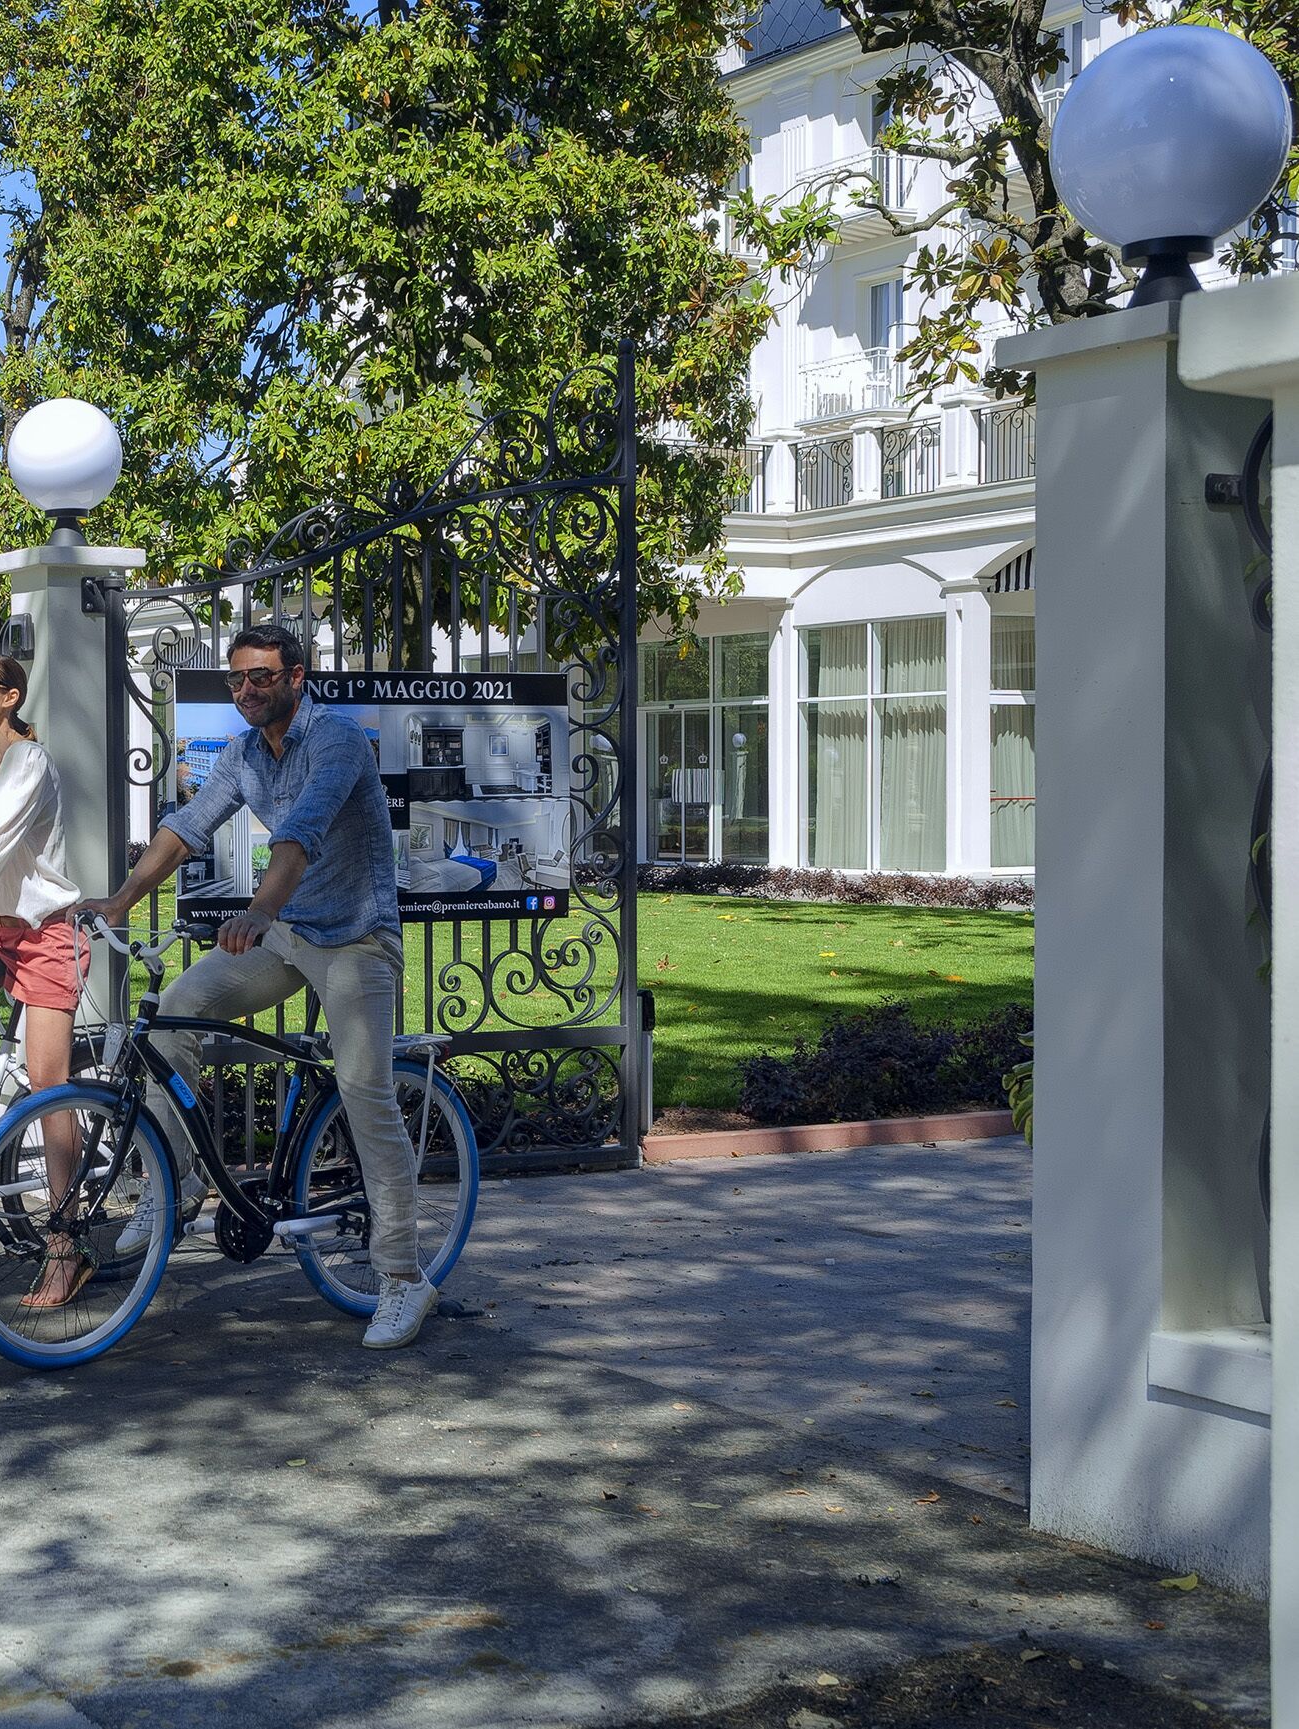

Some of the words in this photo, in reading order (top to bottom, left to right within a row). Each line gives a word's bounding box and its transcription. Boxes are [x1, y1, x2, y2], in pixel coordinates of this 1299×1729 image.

[372, 680, 467, 700] MAGGIO
[471, 680, 513, 700] 2021
[385, 794, 405, 808] ÈRE
[190, 907, 250, 921] www.prem
